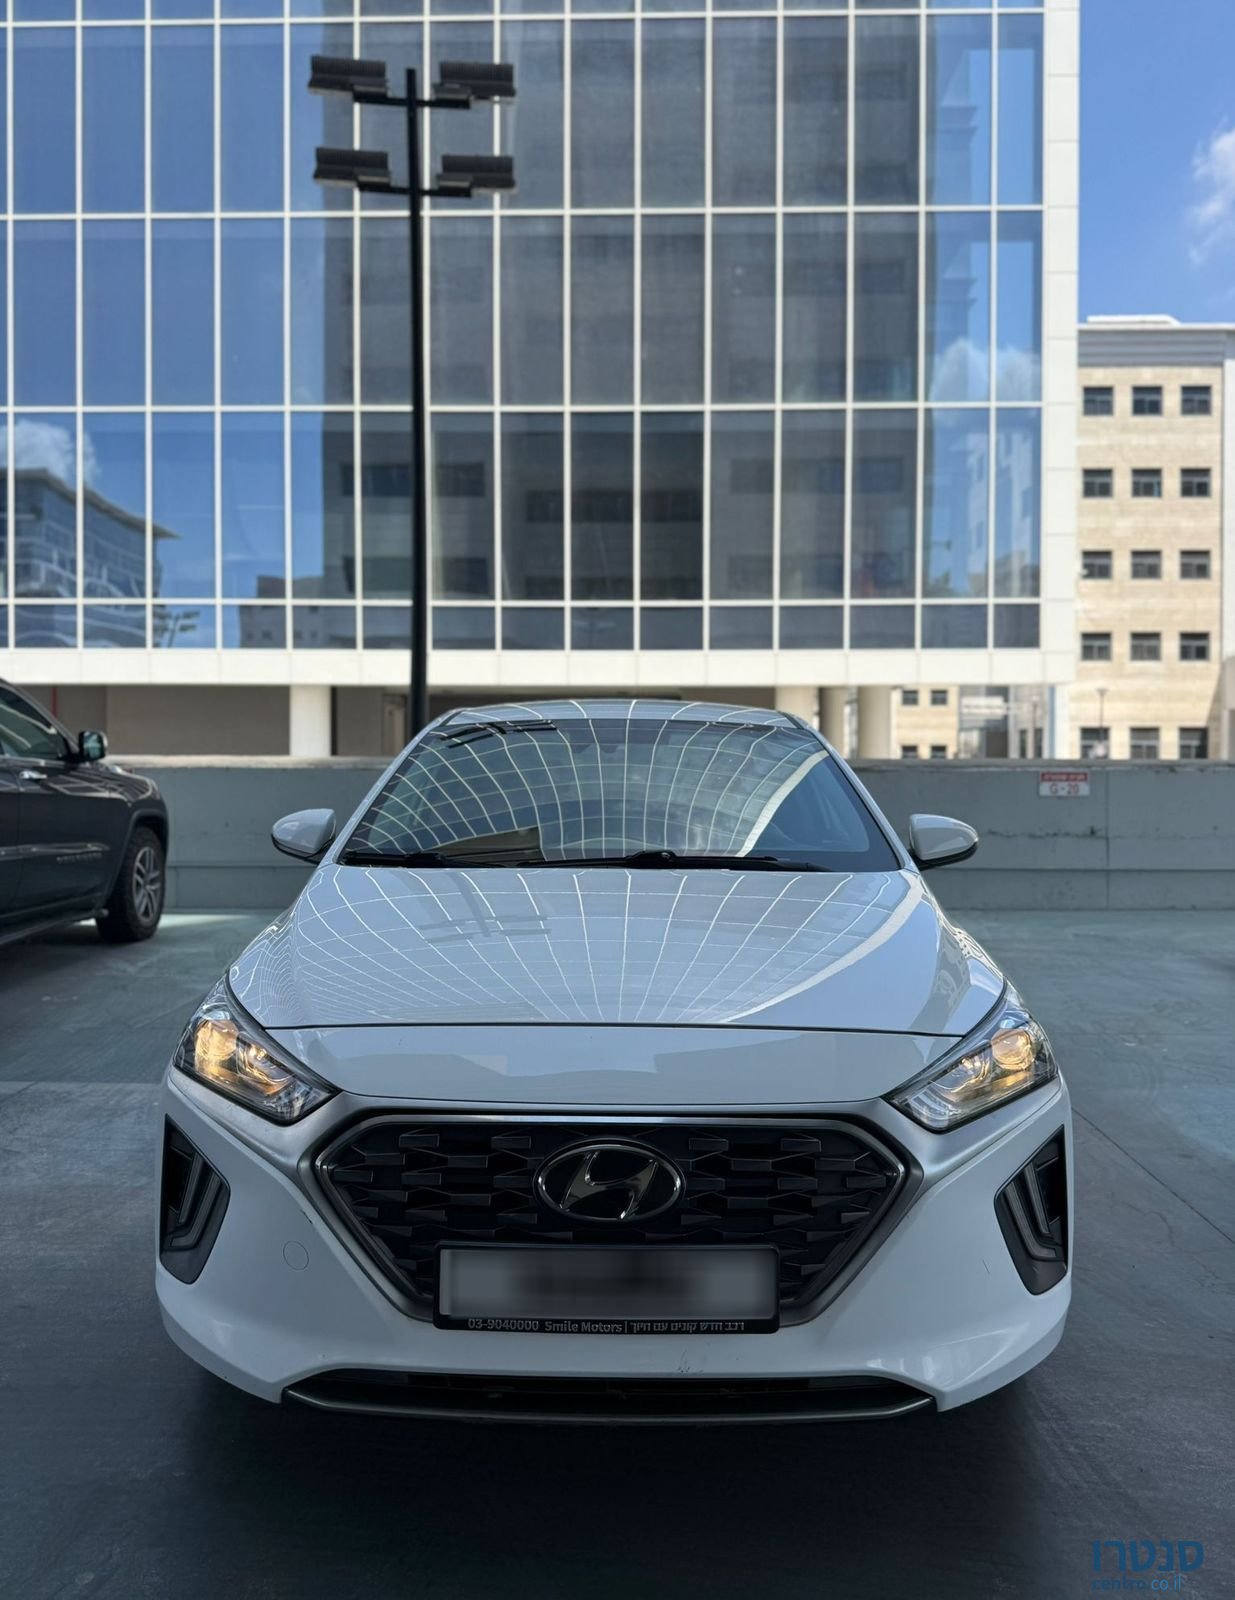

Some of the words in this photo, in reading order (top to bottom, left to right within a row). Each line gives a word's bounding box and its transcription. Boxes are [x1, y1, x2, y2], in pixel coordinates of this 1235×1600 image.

[467, 1318, 539, 1331] 03-9040000
[544, 1320, 579, 1332] Smile
[580, 1321, 623, 1333] Motors
[653, 1321, 669, 1331] עם
[670, 1321, 698, 1334] קונים
[700, 1321, 723, 1331] חדש
